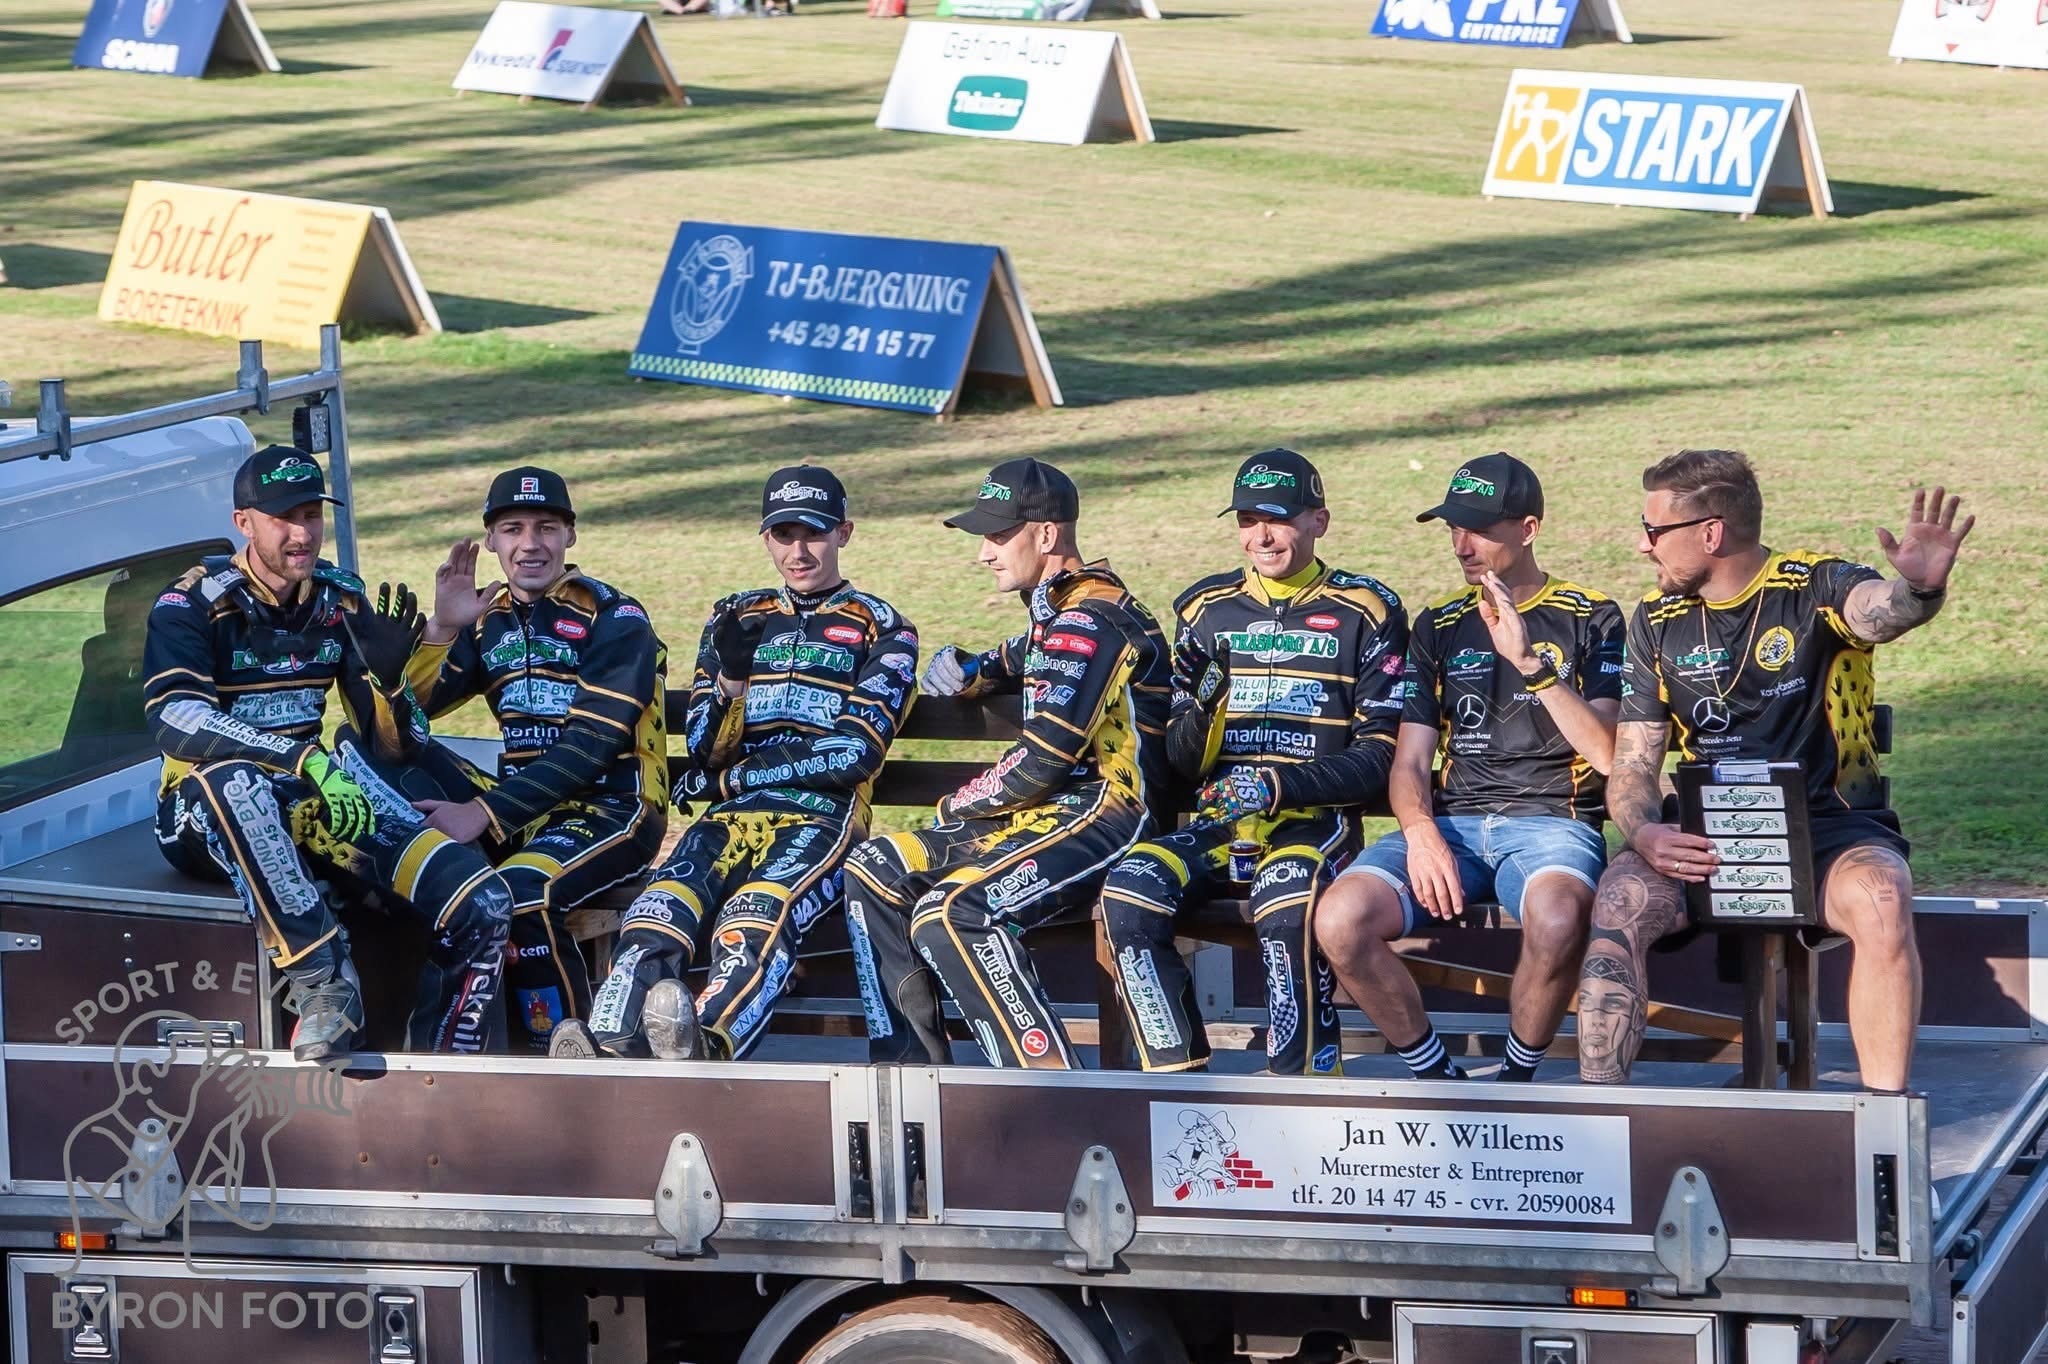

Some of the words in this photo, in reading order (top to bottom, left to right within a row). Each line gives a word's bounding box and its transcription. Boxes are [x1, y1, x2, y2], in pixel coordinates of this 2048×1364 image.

[1573, 98, 1776, 188] STARK
[131, 197, 275, 284] Butler
[766, 260, 971, 316] TJ-BJERGNING
[113, 287, 250, 334] BORETEKNIK
[768, 320, 810, 346] +45
[810, 323, 841, 349] 29
[841, 325, 870, 353] 21
[875, 329, 904, 357] 15
[906, 332, 936, 359] 77
[513, 494, 546, 502] BETARD
[1308, 638, 1337, 658] A/S
[826, 650, 854, 672] A/S
[1234, 691, 1247, 701] 44
[1251, 691, 1264, 701] 58
[1268, 691, 1283, 702] 45
[1292, 683, 1321, 694] BYG
[755, 699, 770, 711] 44
[787, 699, 801, 711] 45
[810, 691, 840, 707] BYG
[234, 708, 249, 719] 24
[270, 705, 282, 716] 58
[285, 703, 297, 713] 45
[860, 706, 886, 733] VVS
[747, 765, 793, 786] DANO
[793, 756, 826, 776] VVS
[227, 782, 256, 824] BYG
[1764, 794, 1777, 803] A/S
[264, 824, 279, 842] 45
[1766, 820, 1779, 829] A/S
[276, 846, 290, 866] 58
[866, 843, 888, 865] BYG
[1768, 847, 1782, 856] A/S
[250, 826, 302, 914] JØRLUNDE
[286, 869, 302, 886] 44
[1259, 860, 1300, 878] NIKKEL
[1250, 868, 1308, 898] CHROM
[1770, 875, 1784, 883] A/S
[296, 889, 313, 910] 24
[1772, 902, 1786, 911] A/S
[1120, 956, 1137, 984] BYG
[1275, 941, 1290, 997] EFFEKTIV
[605, 989, 617, 1001] 58
[973, 942, 1036, 1031] SECURITY
[1141, 986, 1153, 999] 45
[601, 1003, 614, 1016] 44
[864, 998, 877, 1016] 44
[1147, 1001, 1161, 1015] 58
[597, 1017, 610, 1031] 24
[1130, 988, 1159, 1048] JØRLUNDE
[1154, 1017, 1167, 1031] 44
[1161, 1033, 1172, 1047] 24
[1339, 1120, 1384, 1151] Jan
[1396, 1122, 1436, 1148] W.
[1446, 1124, 1564, 1152] Willems
[1319, 1157, 1440, 1180] Murermester
[1447, 1163, 1464, 1180] &
[1471, 1165, 1584, 1186] Entreprenør
[1291, 1185, 1324, 1205] tlf.
[1331, 1187, 1356, 1207] 20
[1366, 1187, 1385, 1207] 14
[1393, 1188, 1416, 1208] 47
[1424, 1189, 1446, 1209] 45
[1471, 1197, 1508, 1212] cvr.
[1517, 1192, 1616, 1216] 20590084
